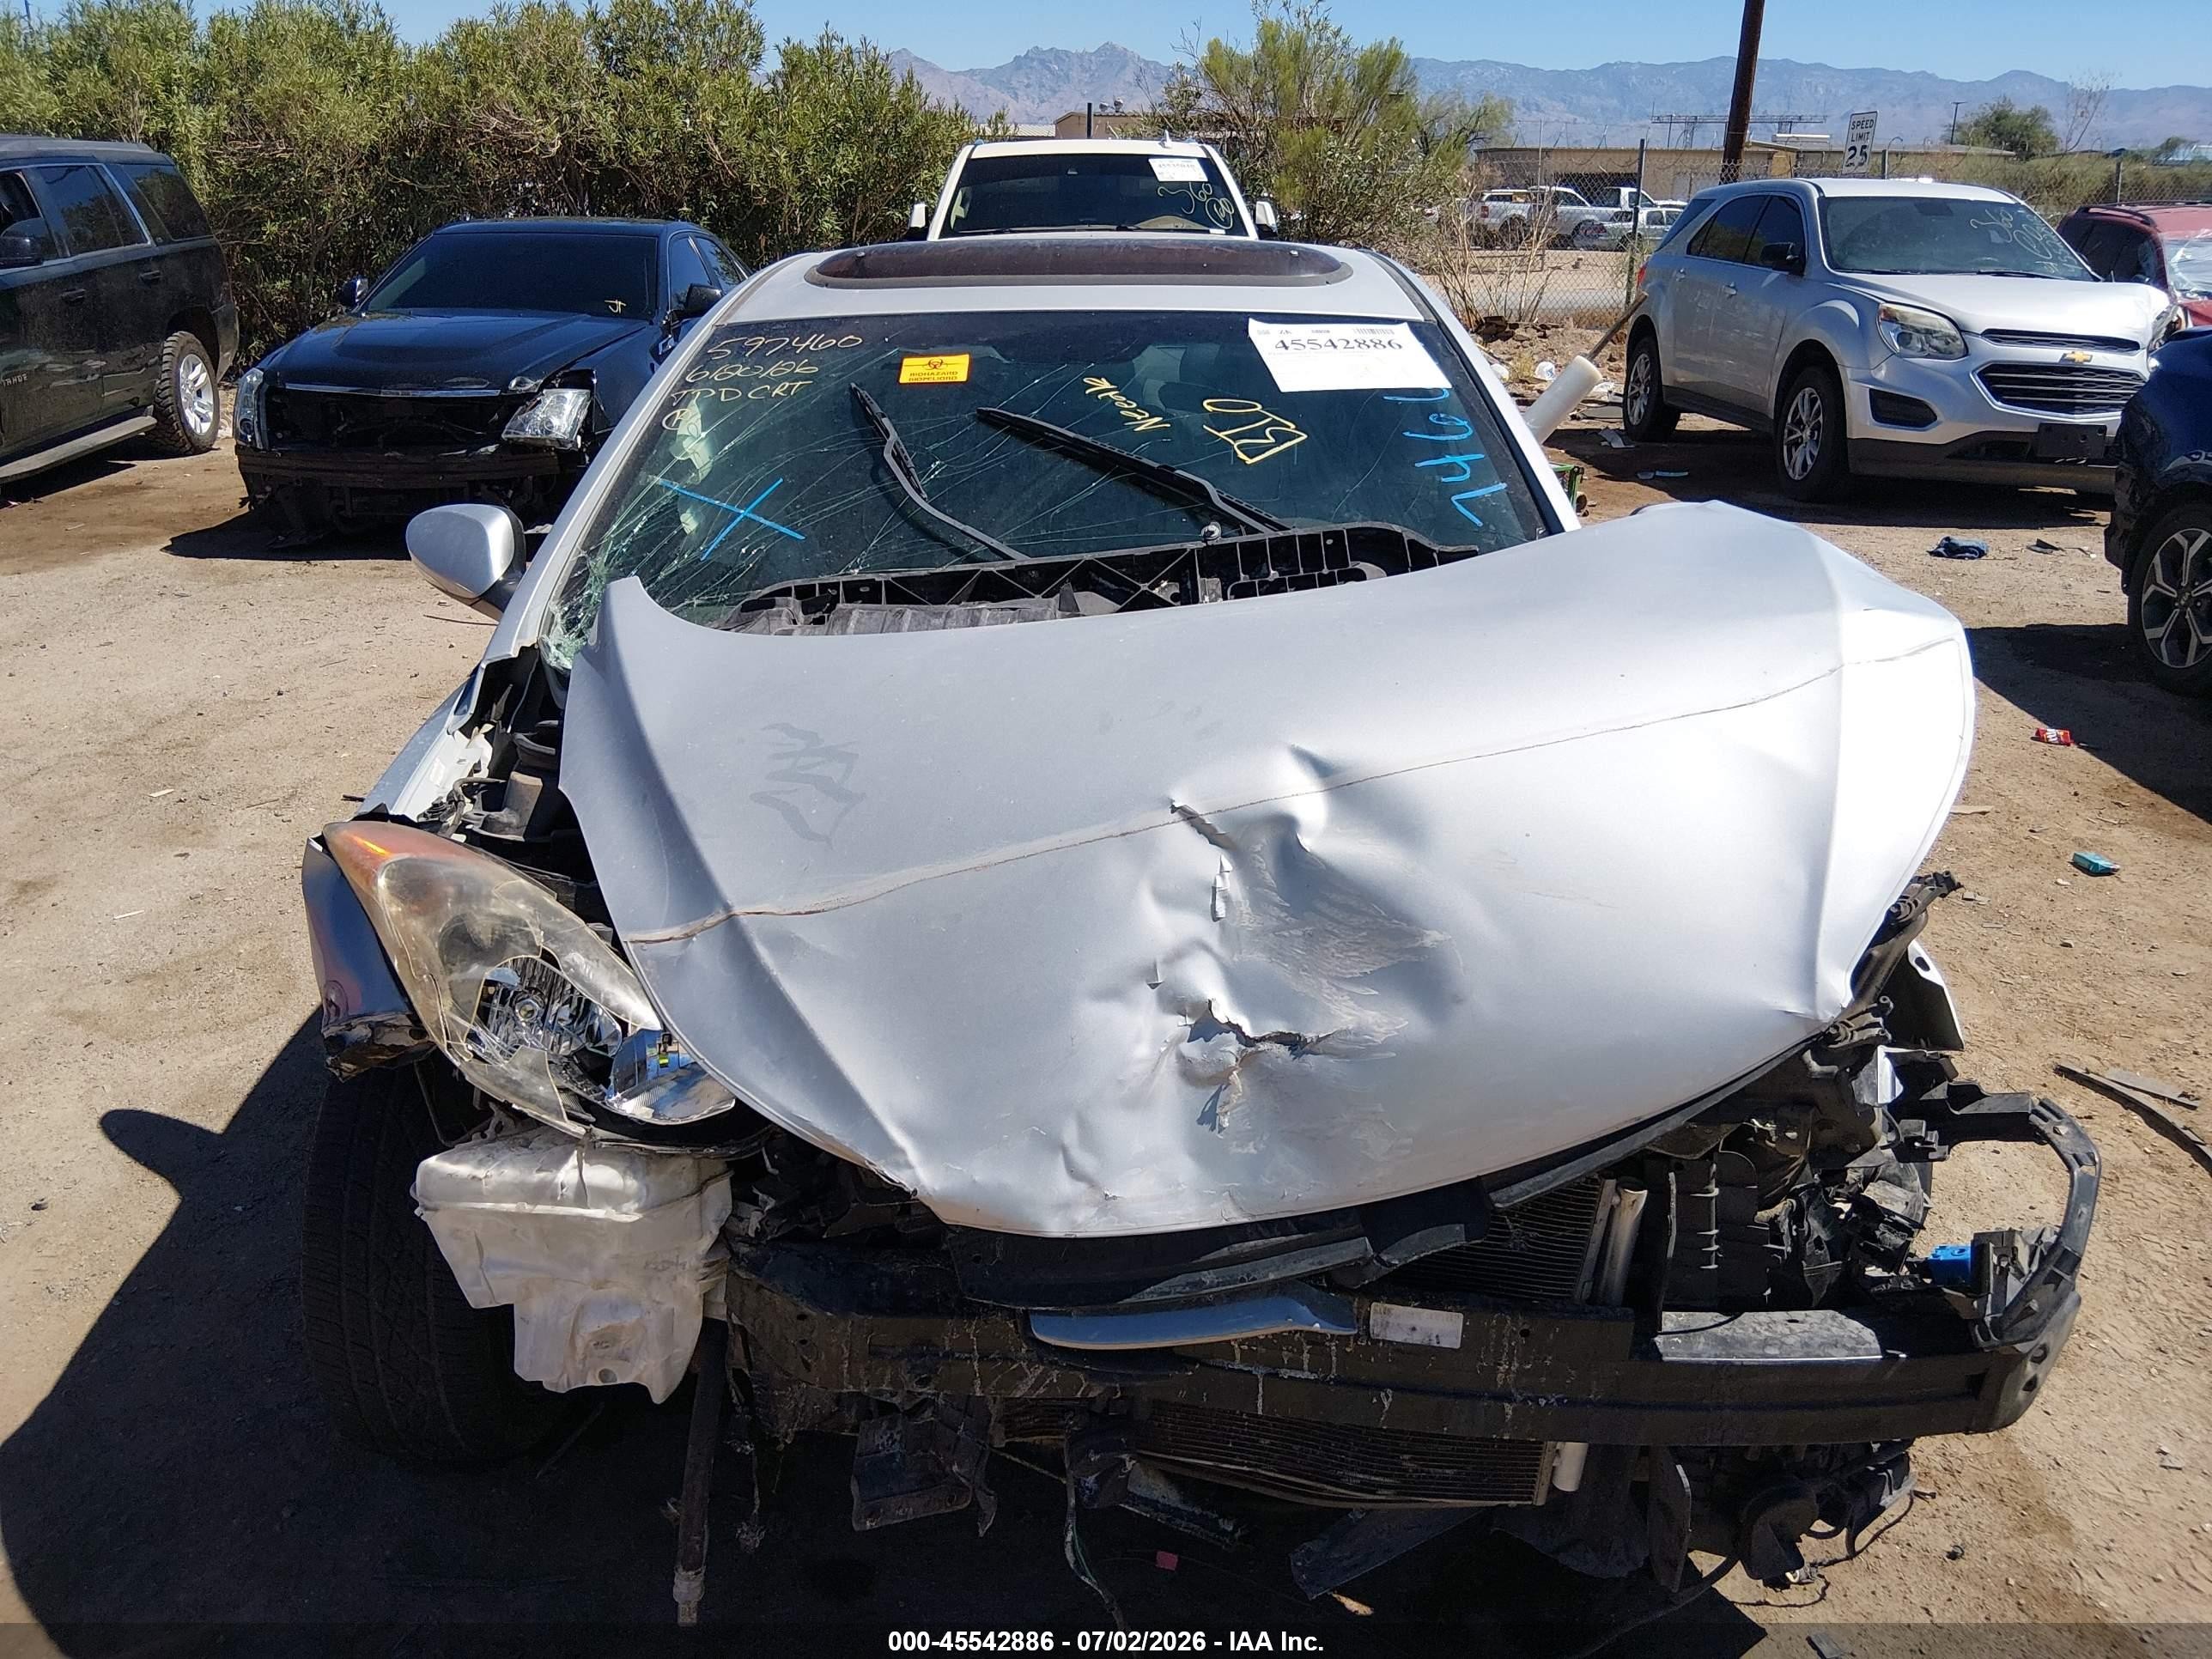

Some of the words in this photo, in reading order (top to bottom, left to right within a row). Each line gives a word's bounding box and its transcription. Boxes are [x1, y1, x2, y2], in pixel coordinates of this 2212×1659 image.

[1850, 119, 1874, 130] SPEED
[1850, 131, 1870, 143] LIMIT
[1844, 144, 1869, 167] 25
[707, 333, 864, 361] 597460
[1274, 338, 1403, 351] 45542886
[1202, 398, 1309, 465] BIO
